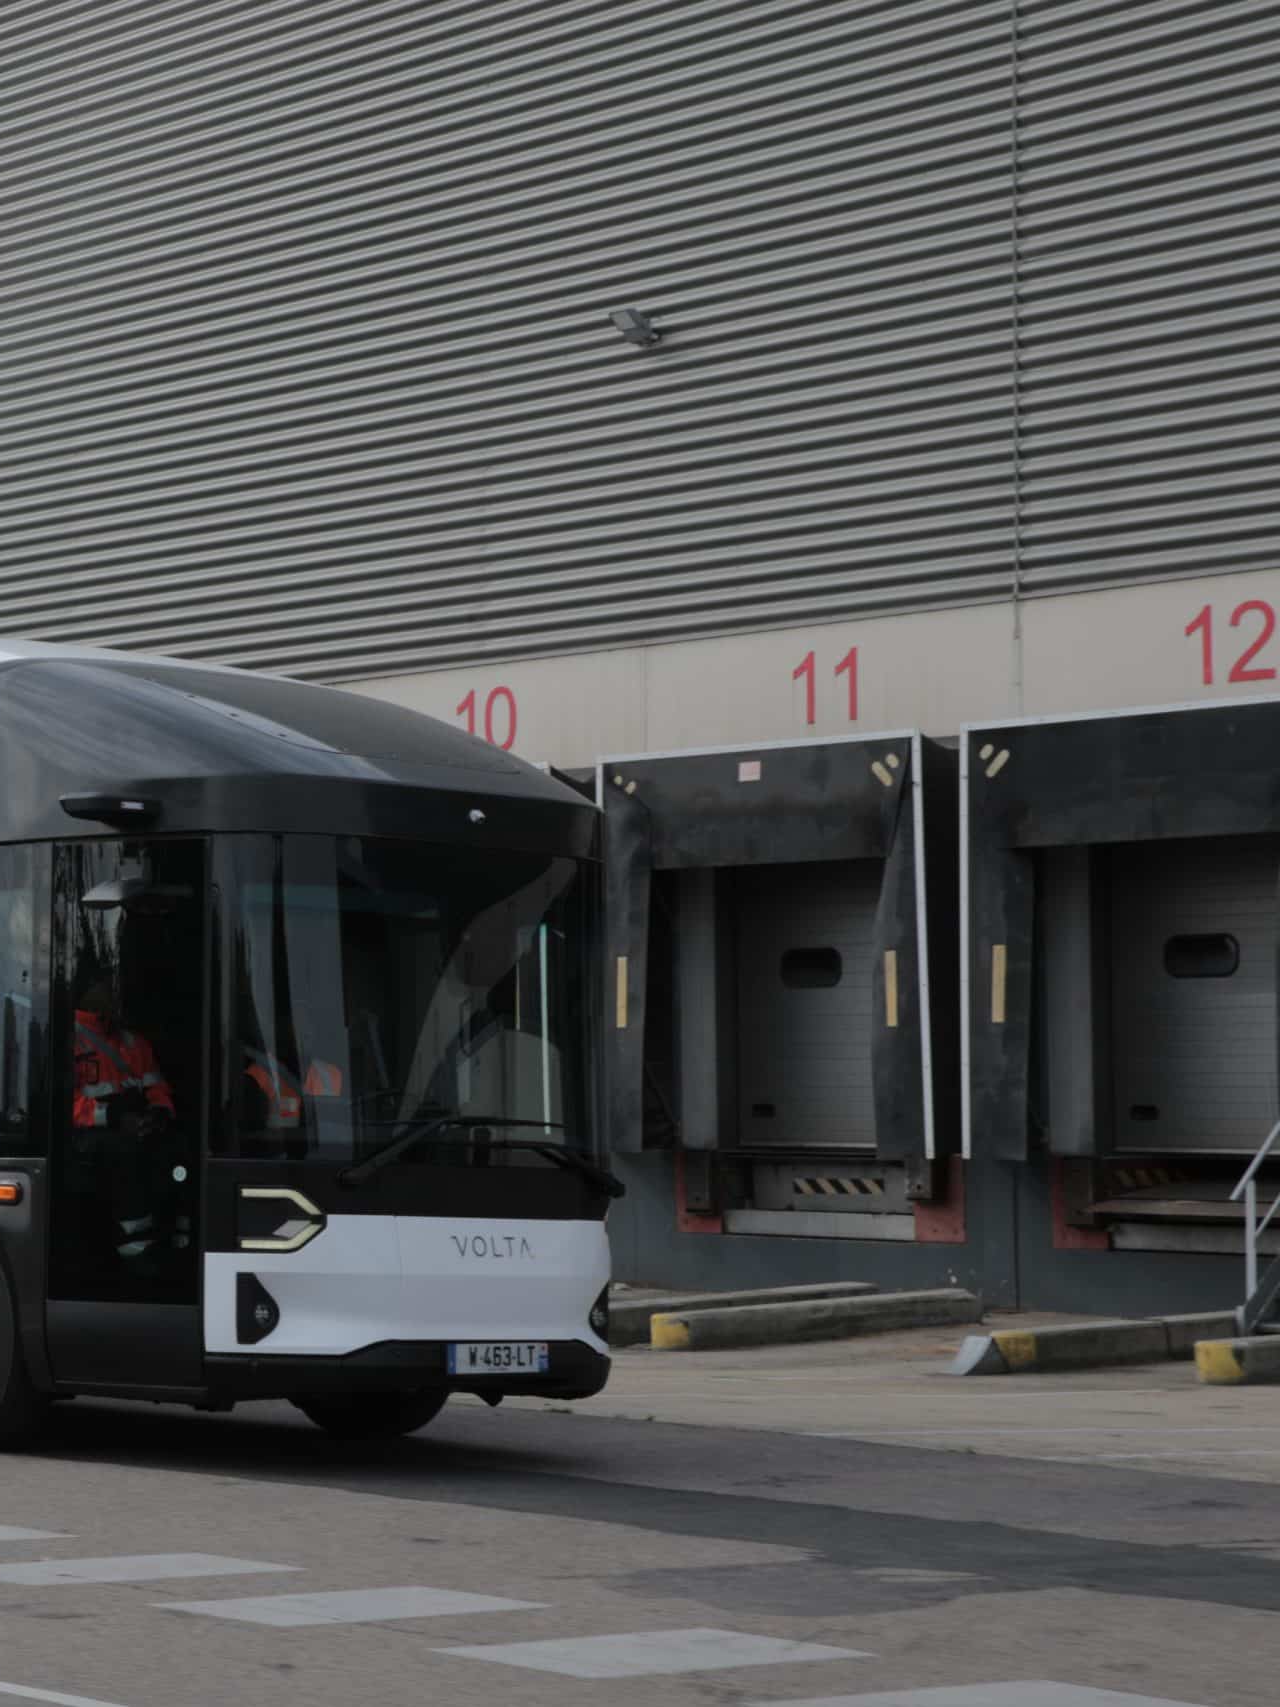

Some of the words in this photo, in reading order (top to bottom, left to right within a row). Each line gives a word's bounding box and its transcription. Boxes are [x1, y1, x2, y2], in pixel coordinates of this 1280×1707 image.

[1184, 600, 1276, 685] 12
[456, 686, 517, 751] 10
[792, 646, 858, 725] 11
[450, 1235, 534, 1258] VOLTA
